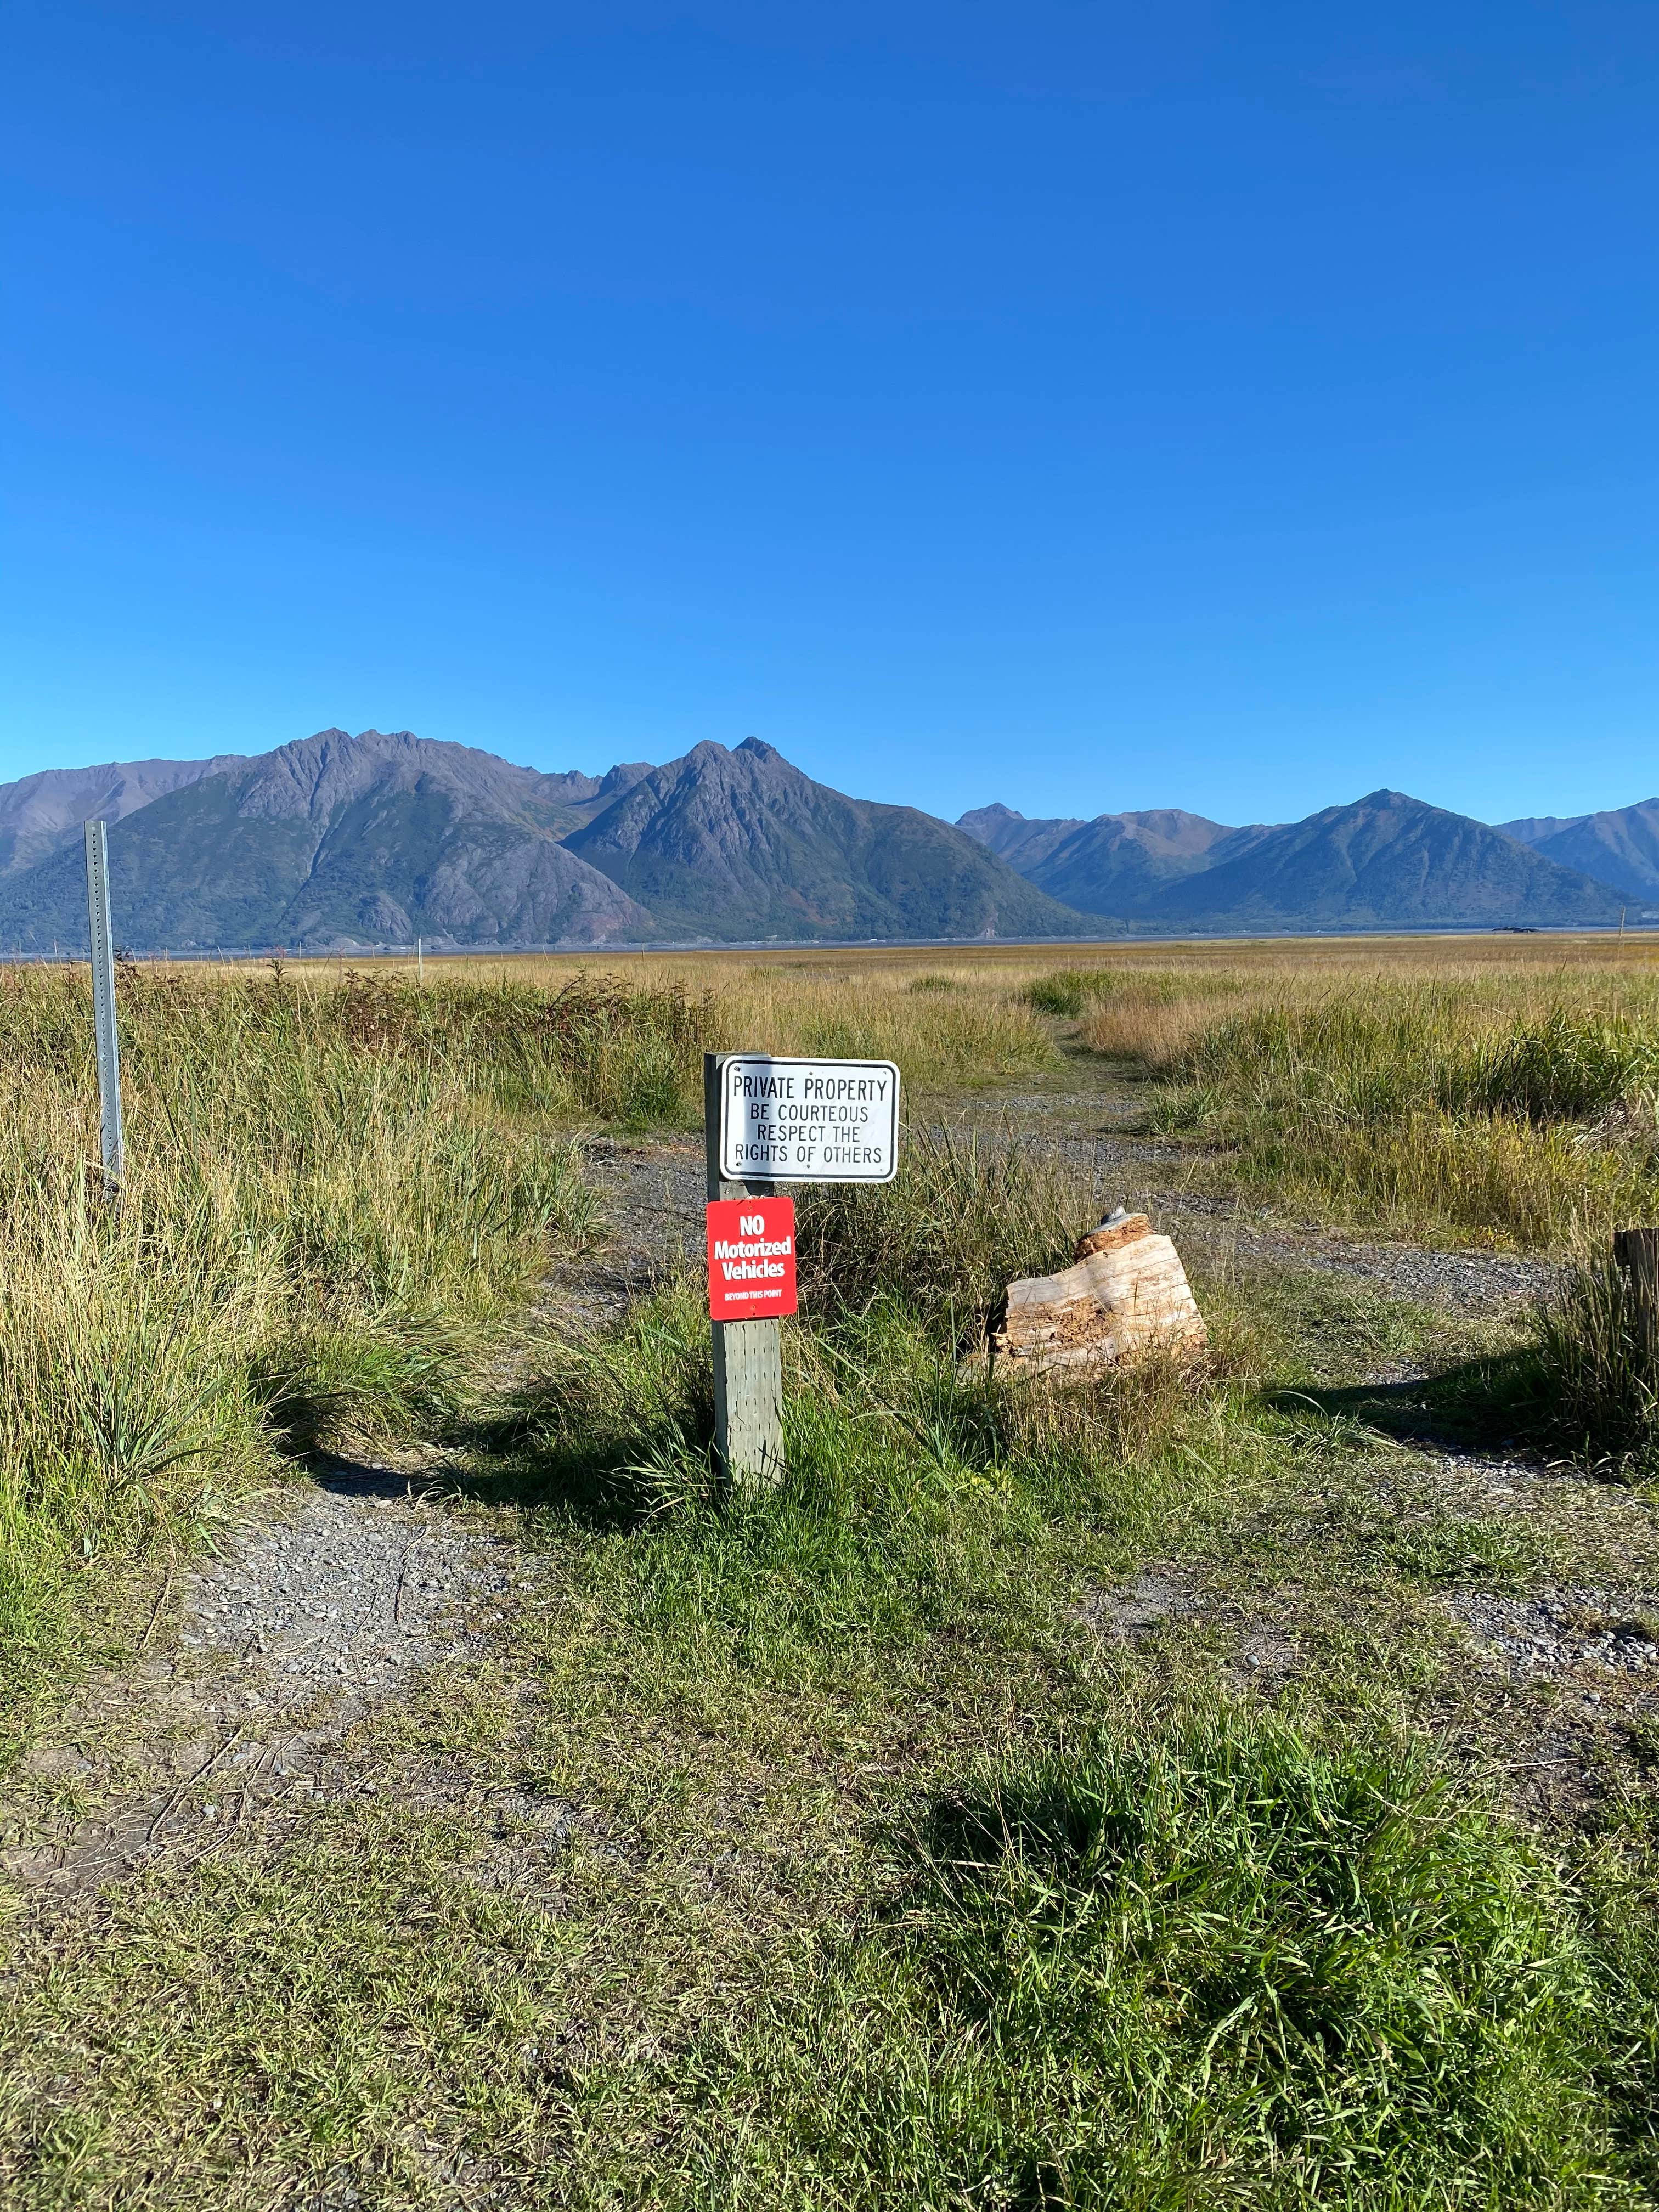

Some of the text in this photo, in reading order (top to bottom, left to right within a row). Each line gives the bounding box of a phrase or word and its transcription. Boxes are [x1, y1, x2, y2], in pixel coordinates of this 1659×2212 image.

[734, 1076, 887, 1101] PRIVATE PROPERTY
[751, 1103, 868, 1122] BE COURTEOUS
[758, 1124, 860, 1142] RESPECT THE
[735, 1143, 882, 1163] RIGHTS OF OTHERS
[740, 1215, 765, 1236] NO
[714, 1235, 791, 1260] Motorized
[721, 1259, 785, 1280] Vehicles
[725, 1289, 782, 1301] BEYOND THIS POINT
